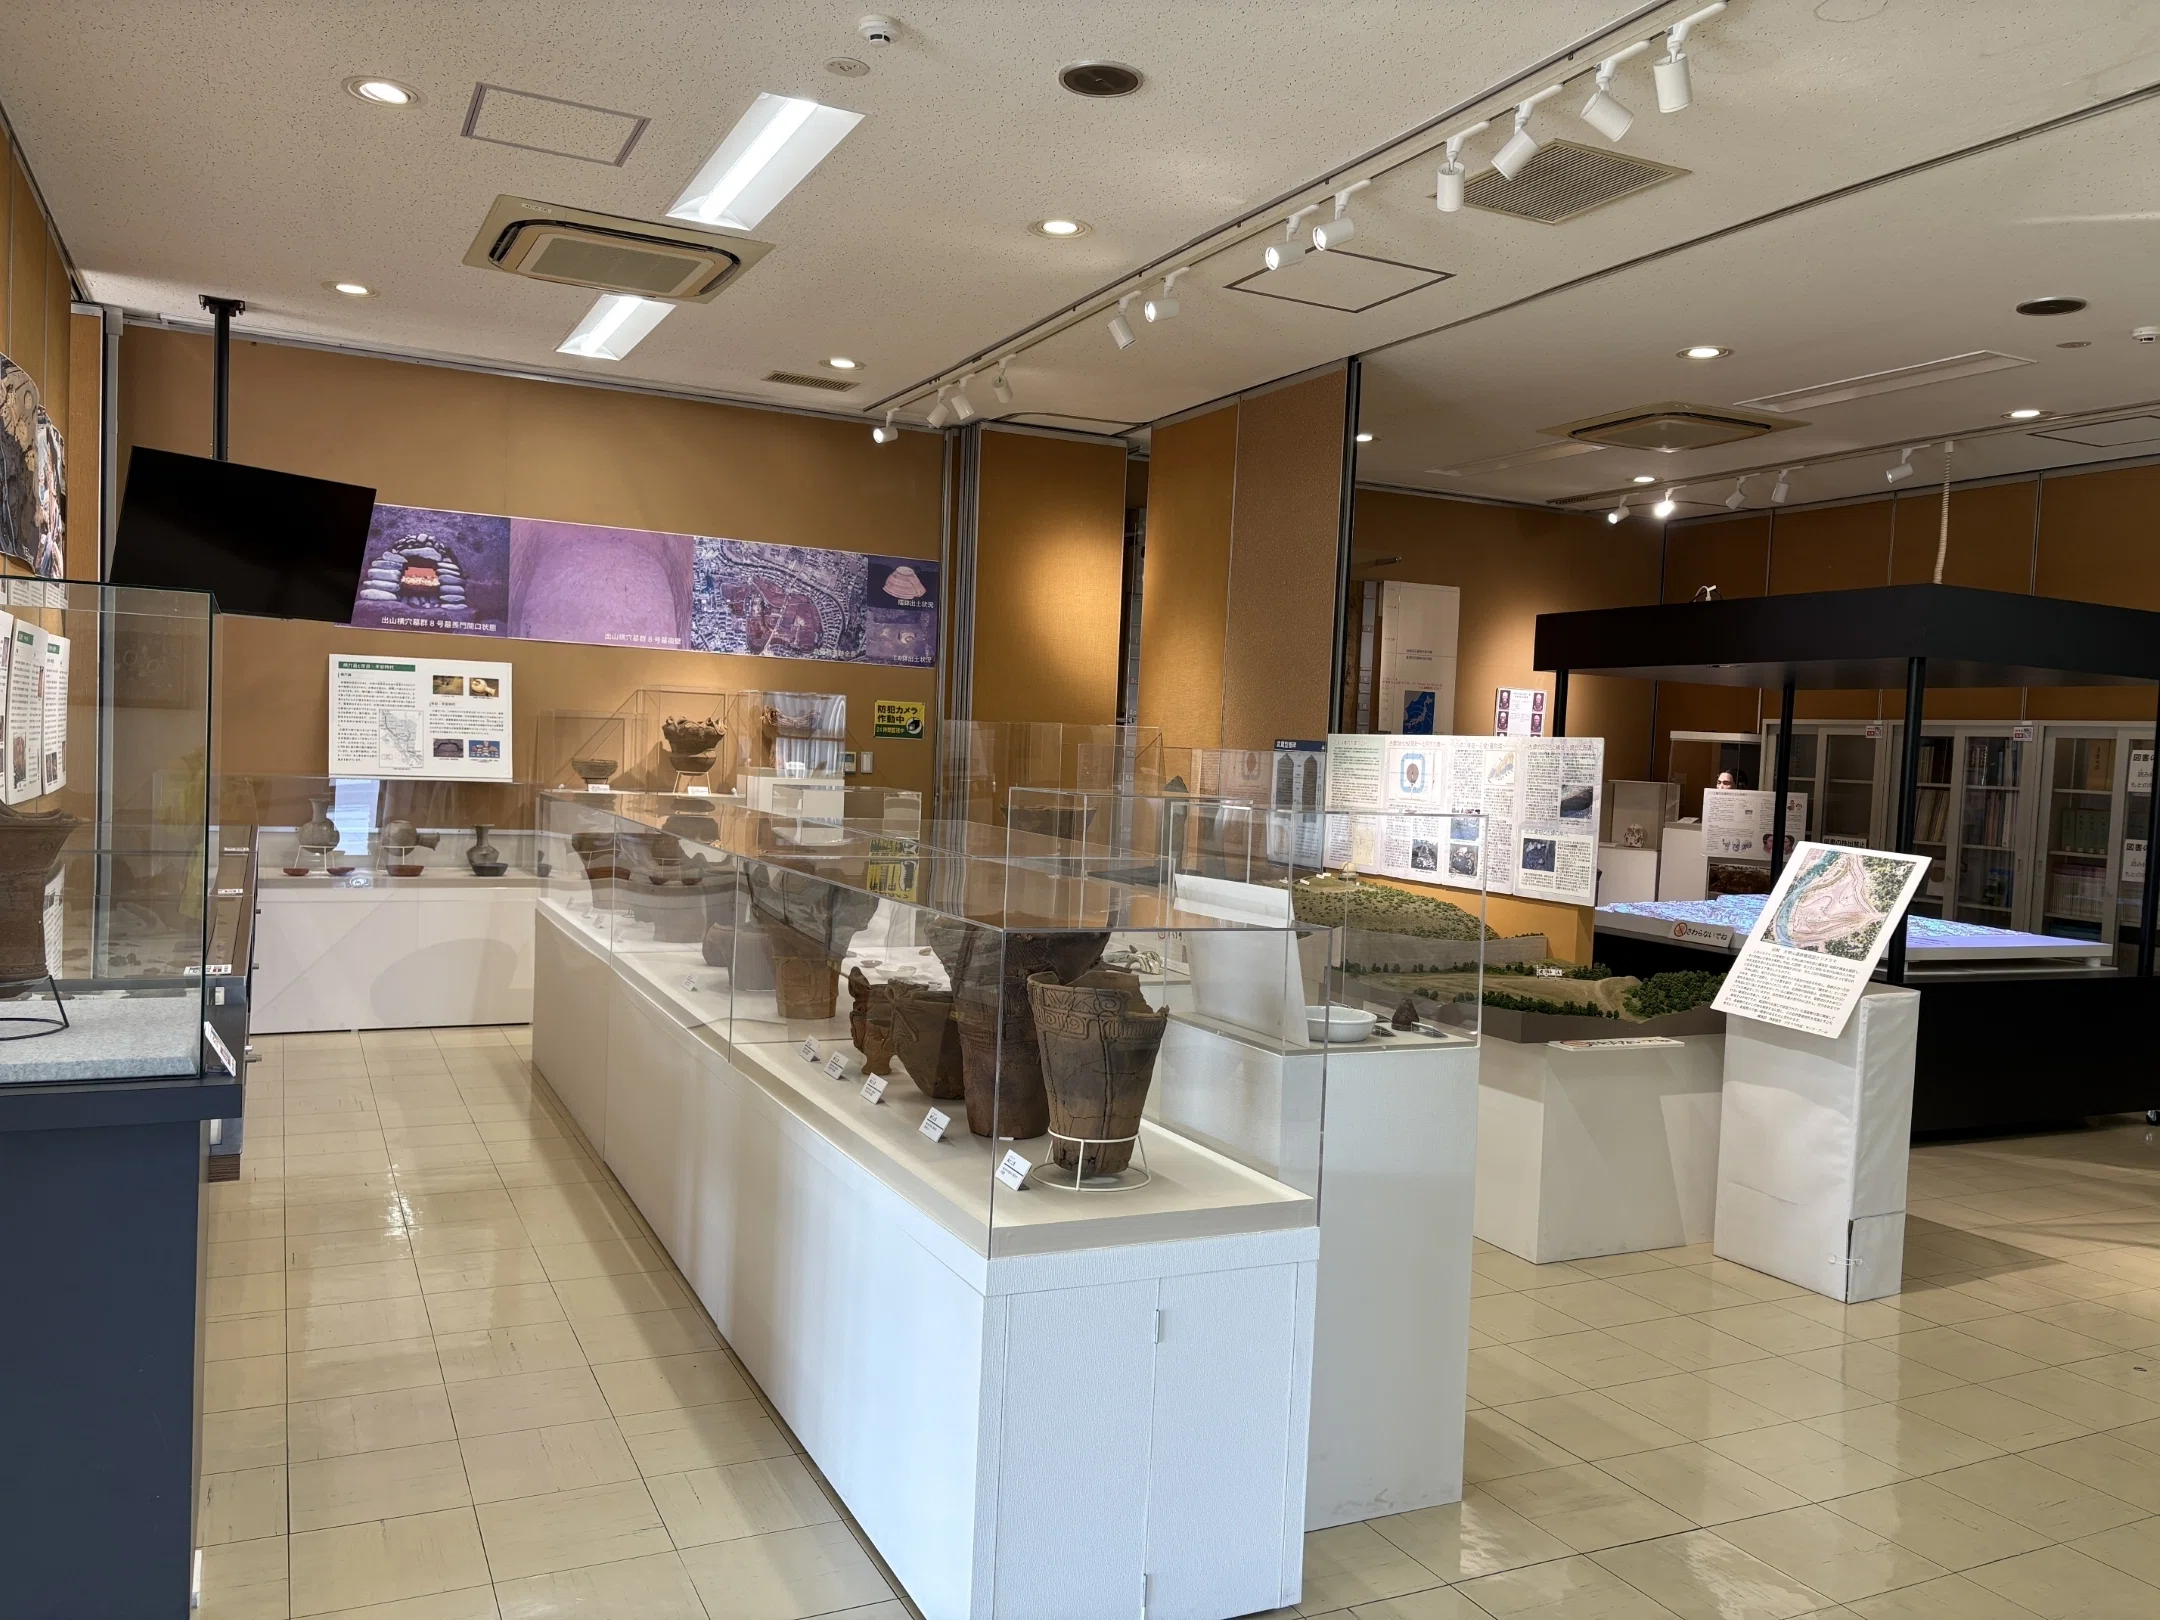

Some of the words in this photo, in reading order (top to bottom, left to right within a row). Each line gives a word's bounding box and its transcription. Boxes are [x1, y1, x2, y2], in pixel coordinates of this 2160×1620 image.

[877, 705, 918, 715] 防犯カメラ
[877, 714, 905, 724] 作動中
[1687, 928, 1727, 940] さわらないでね
